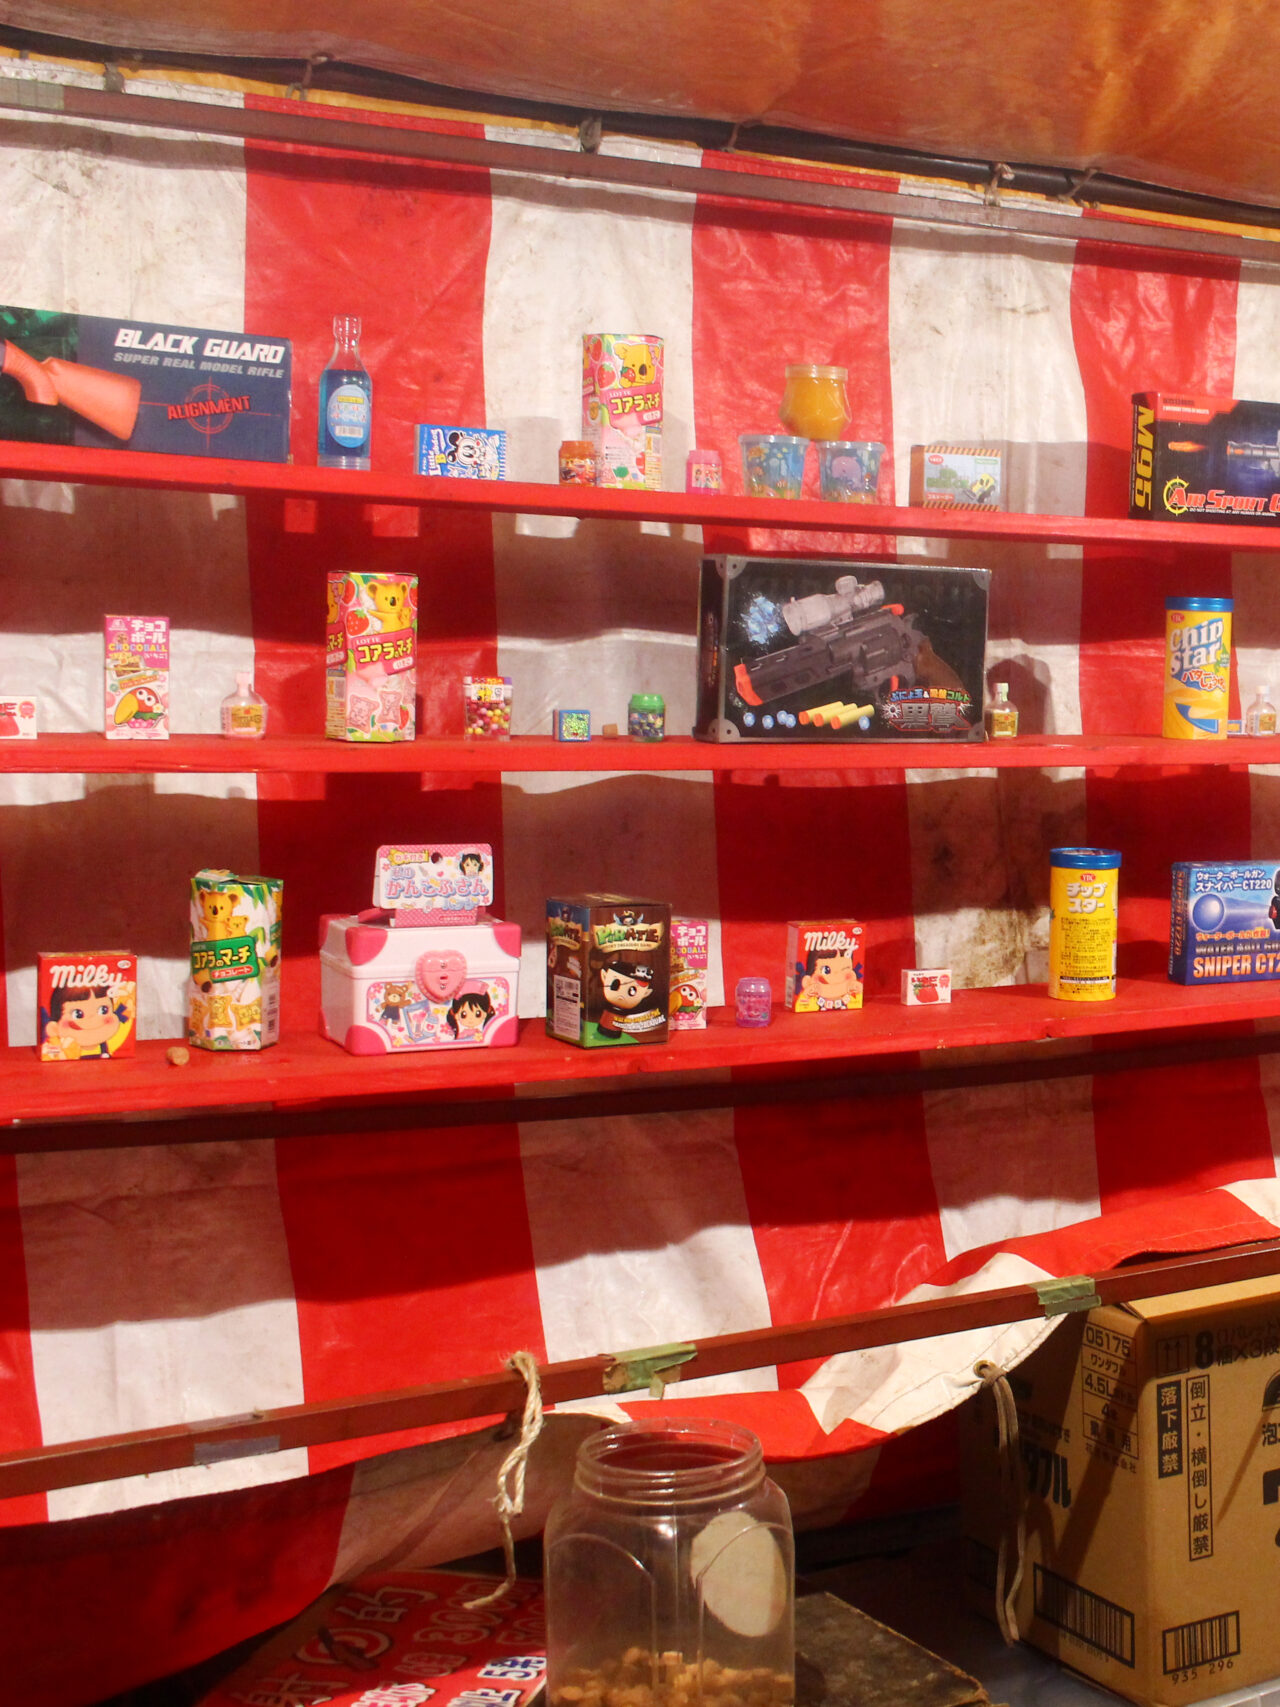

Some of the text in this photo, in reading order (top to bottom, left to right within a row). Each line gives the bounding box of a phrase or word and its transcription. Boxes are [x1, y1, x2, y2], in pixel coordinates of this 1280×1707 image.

[114, 328, 286, 364] BLACK GUARD
[113, 352, 285, 379] SUPER REAL MODEL RIFLE
[167, 395, 251, 421] ALIGNMENT
[1135, 406, 1155, 511] M95
[131, 620, 167, 632] チョコ
[109, 643, 168, 652] CHOCOBALL
[131, 632, 167, 644] ボール
[356, 637, 381, 646] LOTTE
[358, 637, 413, 664] コアラのマーチ
[1195, 879, 1272, 892] スナイパーCT220
[1196, 869, 1265, 881] ウォーターボールガン
[1067, 882, 1108, 898] チップ
[1068, 898, 1105, 913] スター
[596, 927, 660, 946] PIRATE
[677, 925, 706, 937] チョコ
[677, 936, 706, 946] ボール
[804, 931, 859, 958] Milky
[193, 946, 250, 968] コアラのマーチ
[1193, 954, 1252, 978] SNIPER
[49, 964, 128, 998] Milky
[214, 967, 250, 977] チョコレート
[1085, 1326, 1131, 1358] 05175
[1160, 1386, 1180, 1473] 落下厳禁
[1190, 1380, 1210, 1556] 倒立・横倒し厳禁
[1171, 1660, 1234, 1685] 935 296
